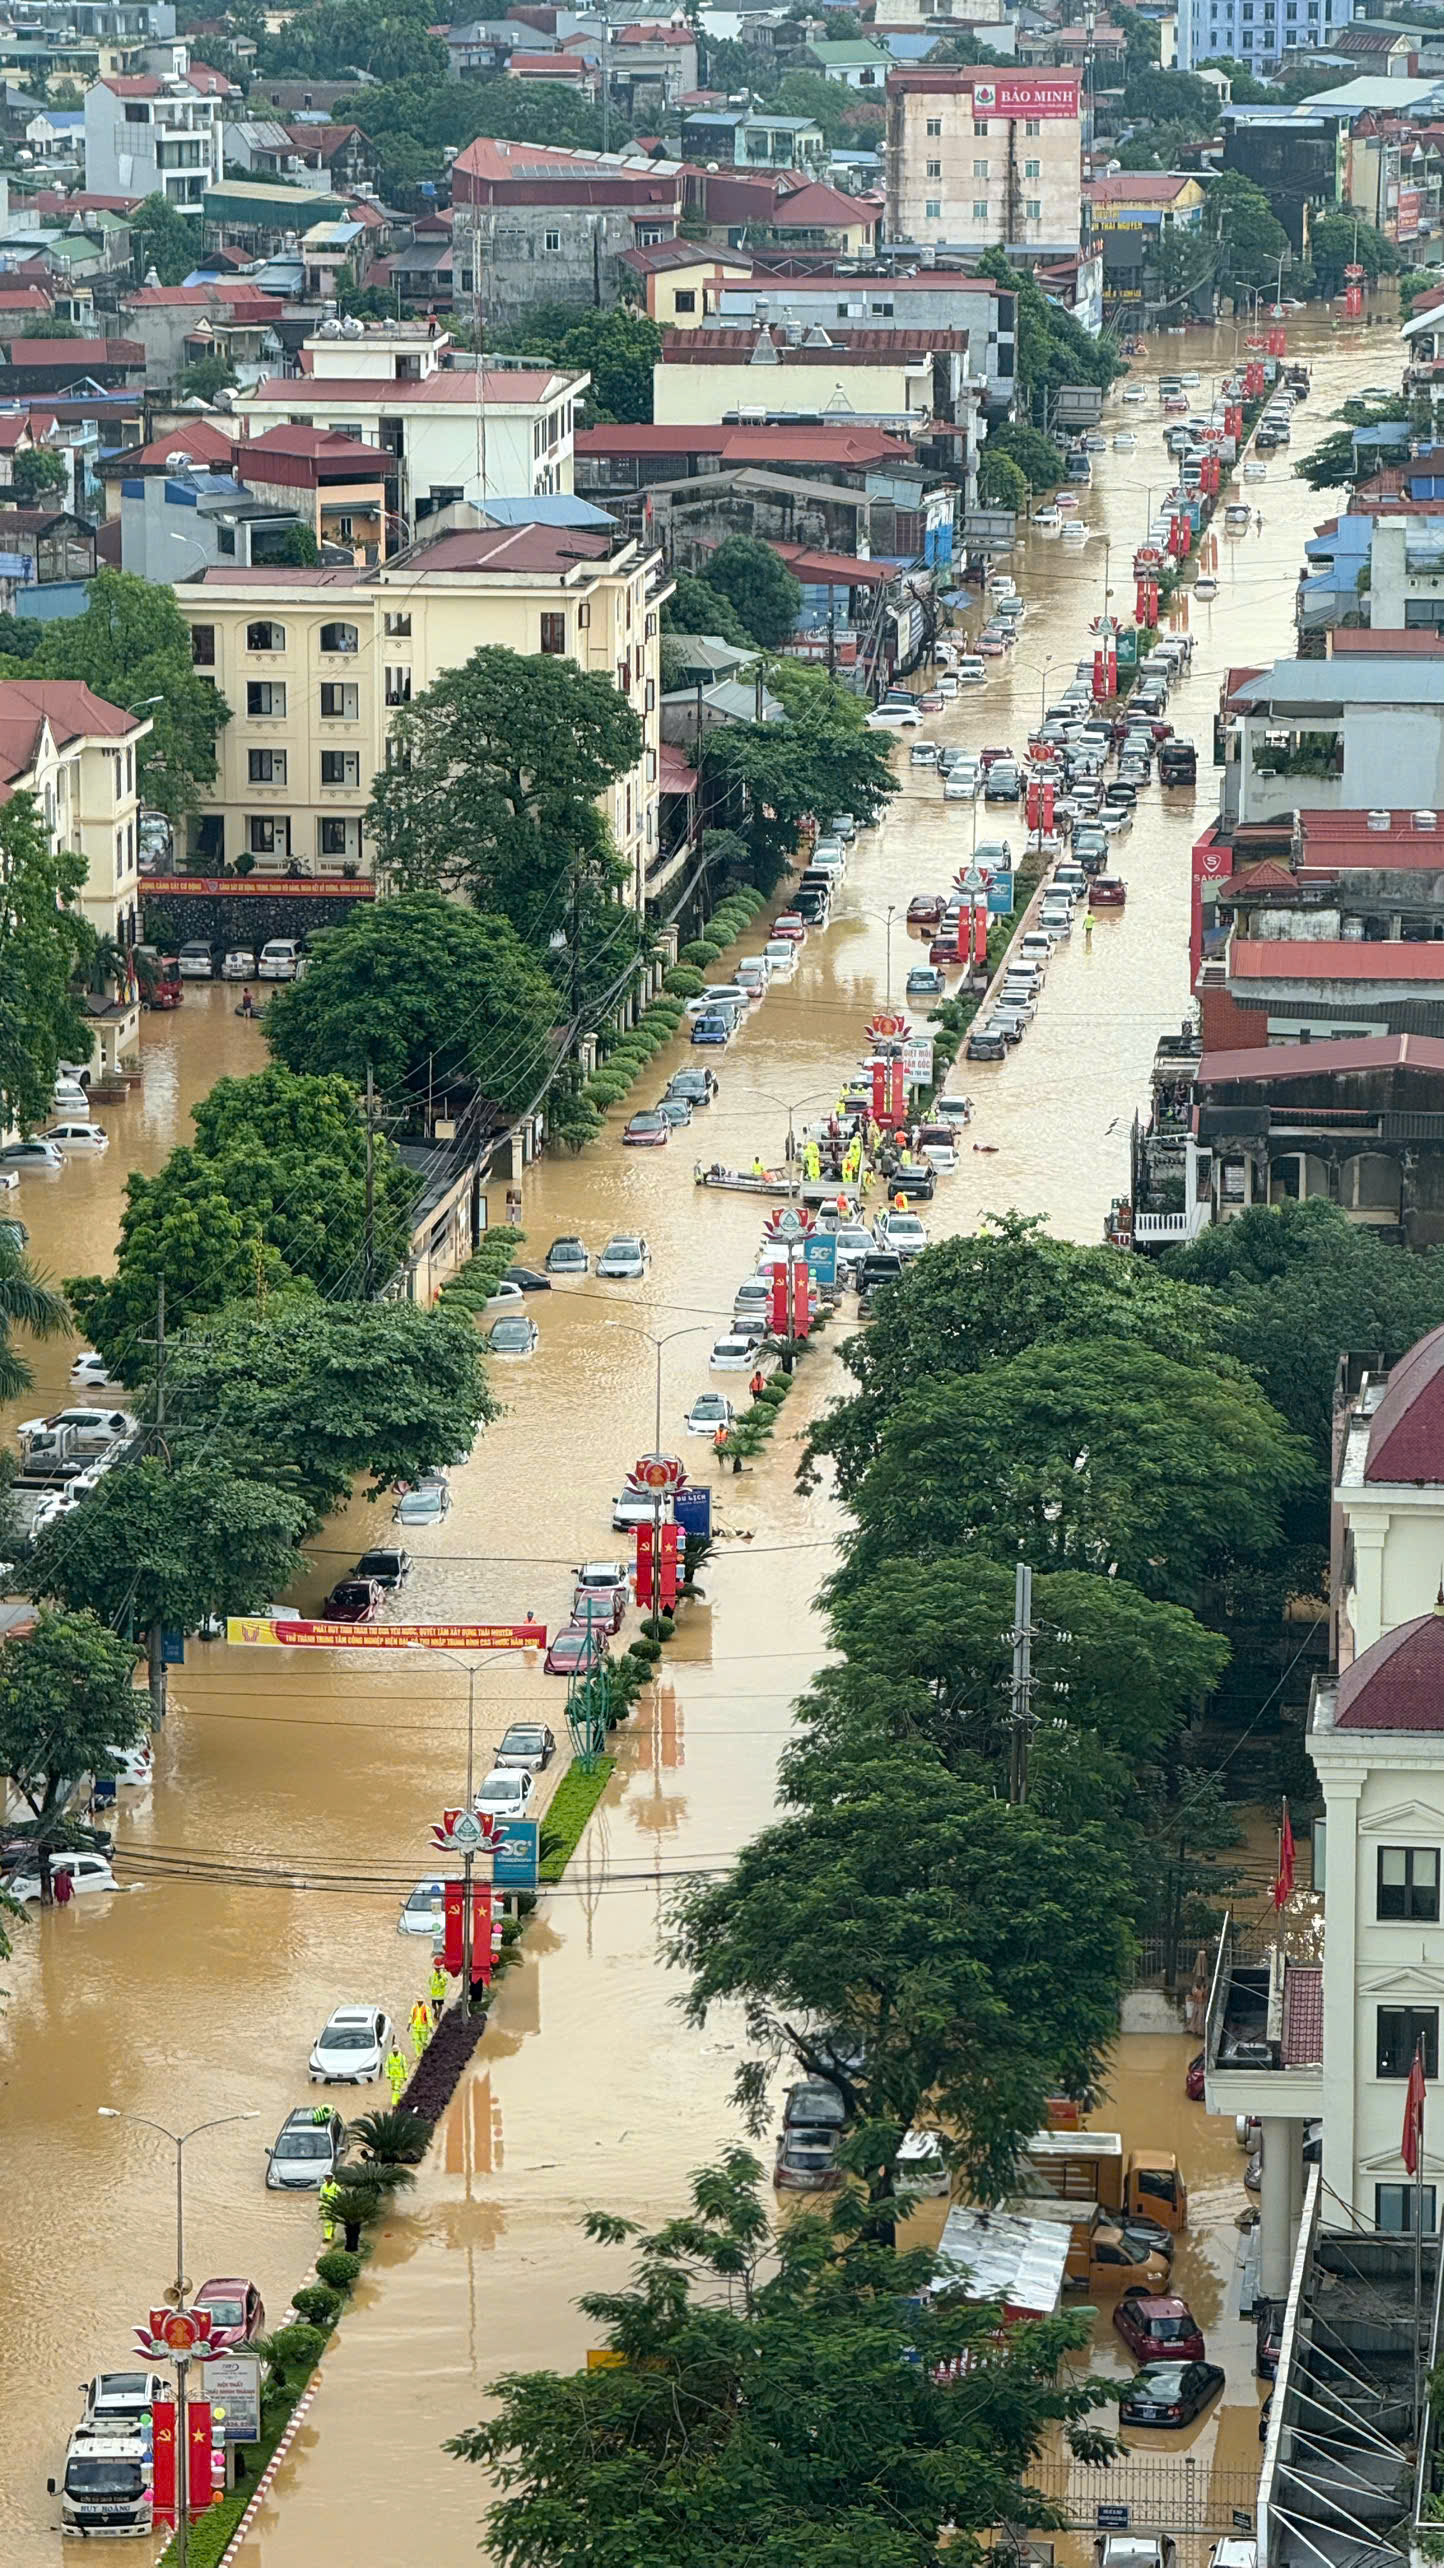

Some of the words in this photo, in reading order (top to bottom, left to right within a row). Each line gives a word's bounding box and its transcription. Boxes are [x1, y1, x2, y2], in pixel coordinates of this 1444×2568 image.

[1001, 86, 1031, 102] BẢO
[1034, 90, 1073, 102] MINH
[313, 1624, 327, 1633] PHÁT
[102, 2504, 131, 2512] HOÀNG
